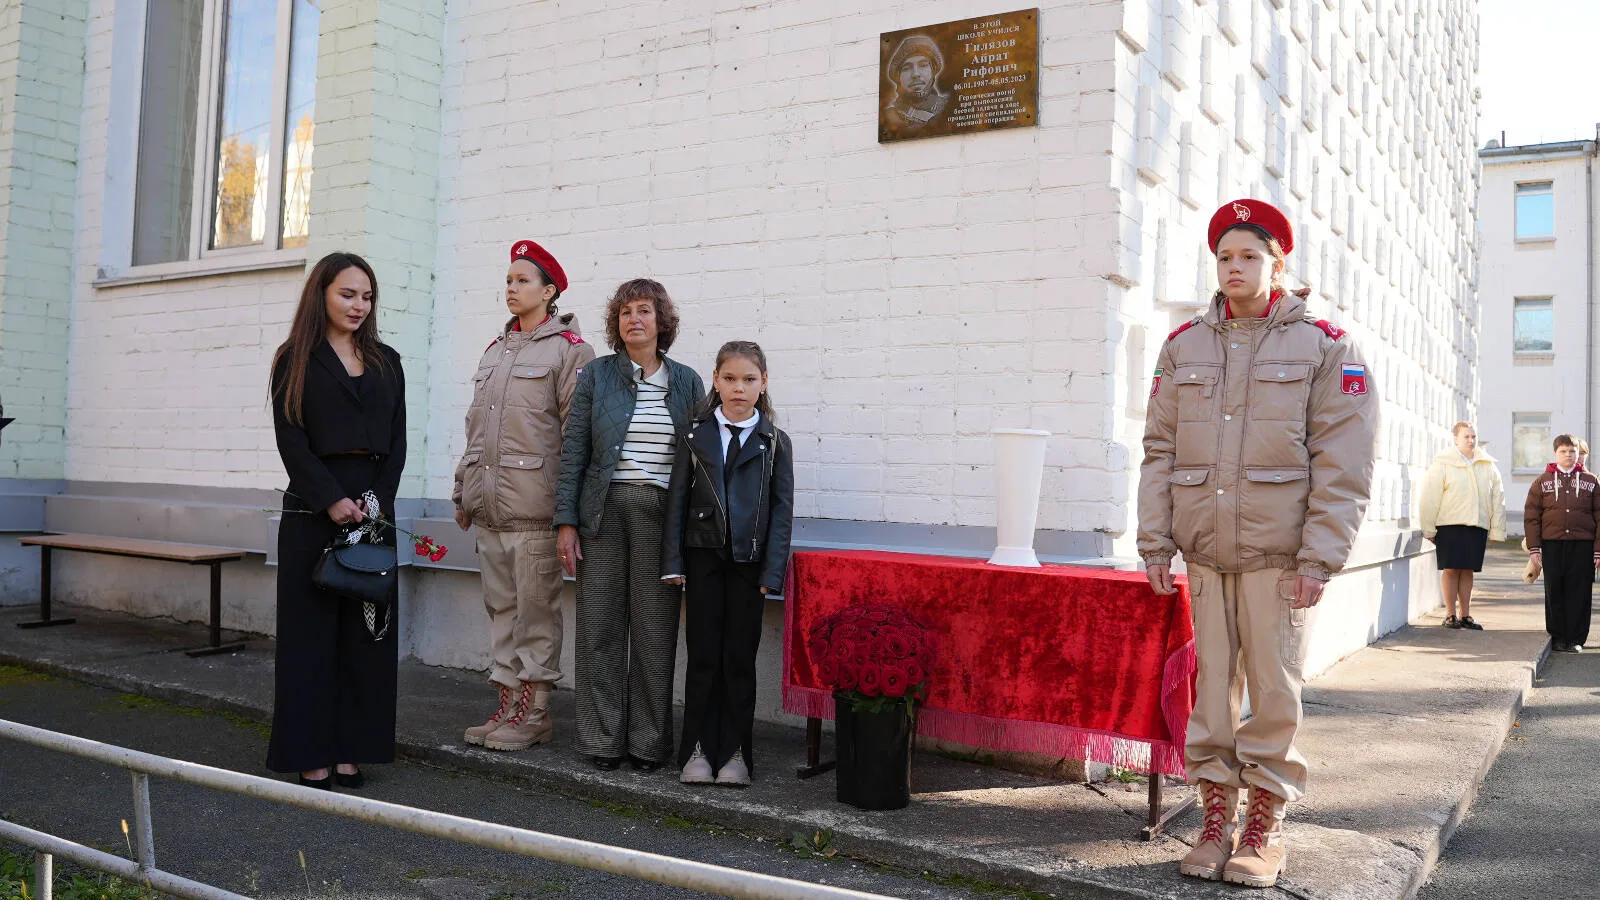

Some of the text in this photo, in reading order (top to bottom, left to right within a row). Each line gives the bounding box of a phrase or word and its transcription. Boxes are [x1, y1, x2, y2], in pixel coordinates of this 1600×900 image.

[981, 20, 1001, 29] ЭТОЙ
[957, 25, 1020, 41] ШКОЛЕ УЧИЛСЯ
[965, 39, 1016, 53] Гилязов
[971, 52, 1009, 65] Айрат
[963, 63, 1017, 78] Рифович
[958, 88, 1016, 102] Героически погиб
[960, 101, 971, 109] при
